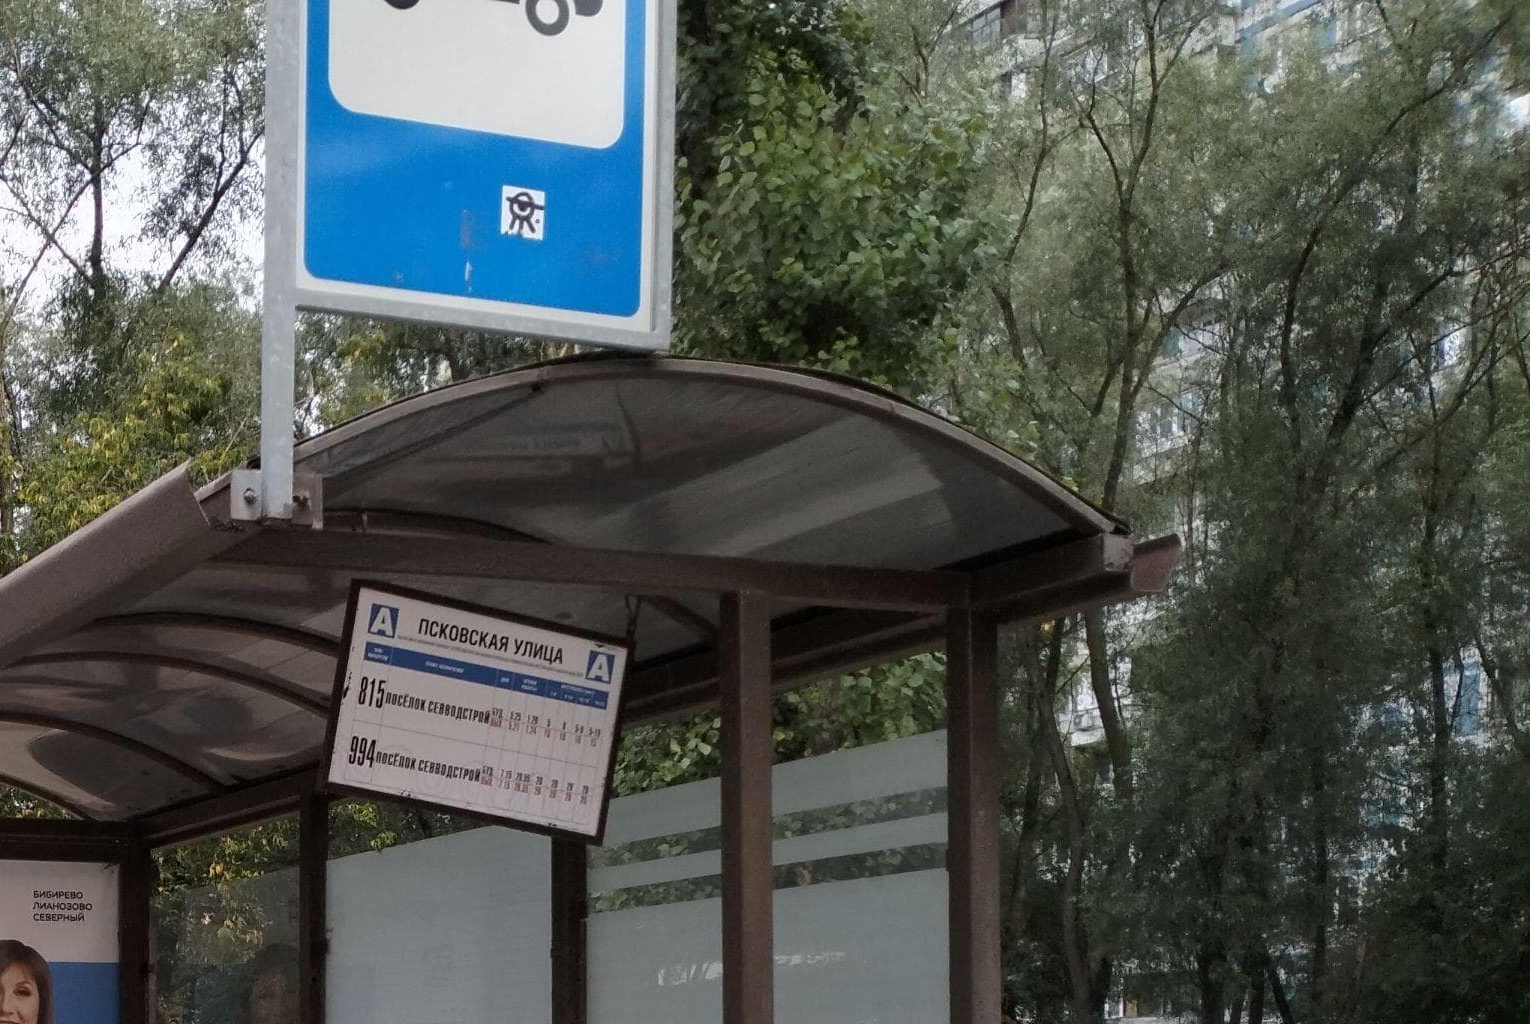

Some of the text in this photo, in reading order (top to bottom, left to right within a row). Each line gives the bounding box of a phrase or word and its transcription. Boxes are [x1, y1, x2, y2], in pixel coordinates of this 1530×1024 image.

[418, 618, 509, 653] ПСКОВСКАЯ
[513, 639, 563, 665] УЛИЦА
[358, 676, 386, 709] 815
[385, 689, 426, 712] ПОСЁЛОК
[348, 736, 376, 769] 994
[375, 750, 416, 773] ПОСЁЛОК
[32, 901, 93, 911] ЛИАНОЗОВО
[33, 890, 83, 899] БИБИРЕВО
[33, 911, 85, 922] СЕВЕРНЫЙ
